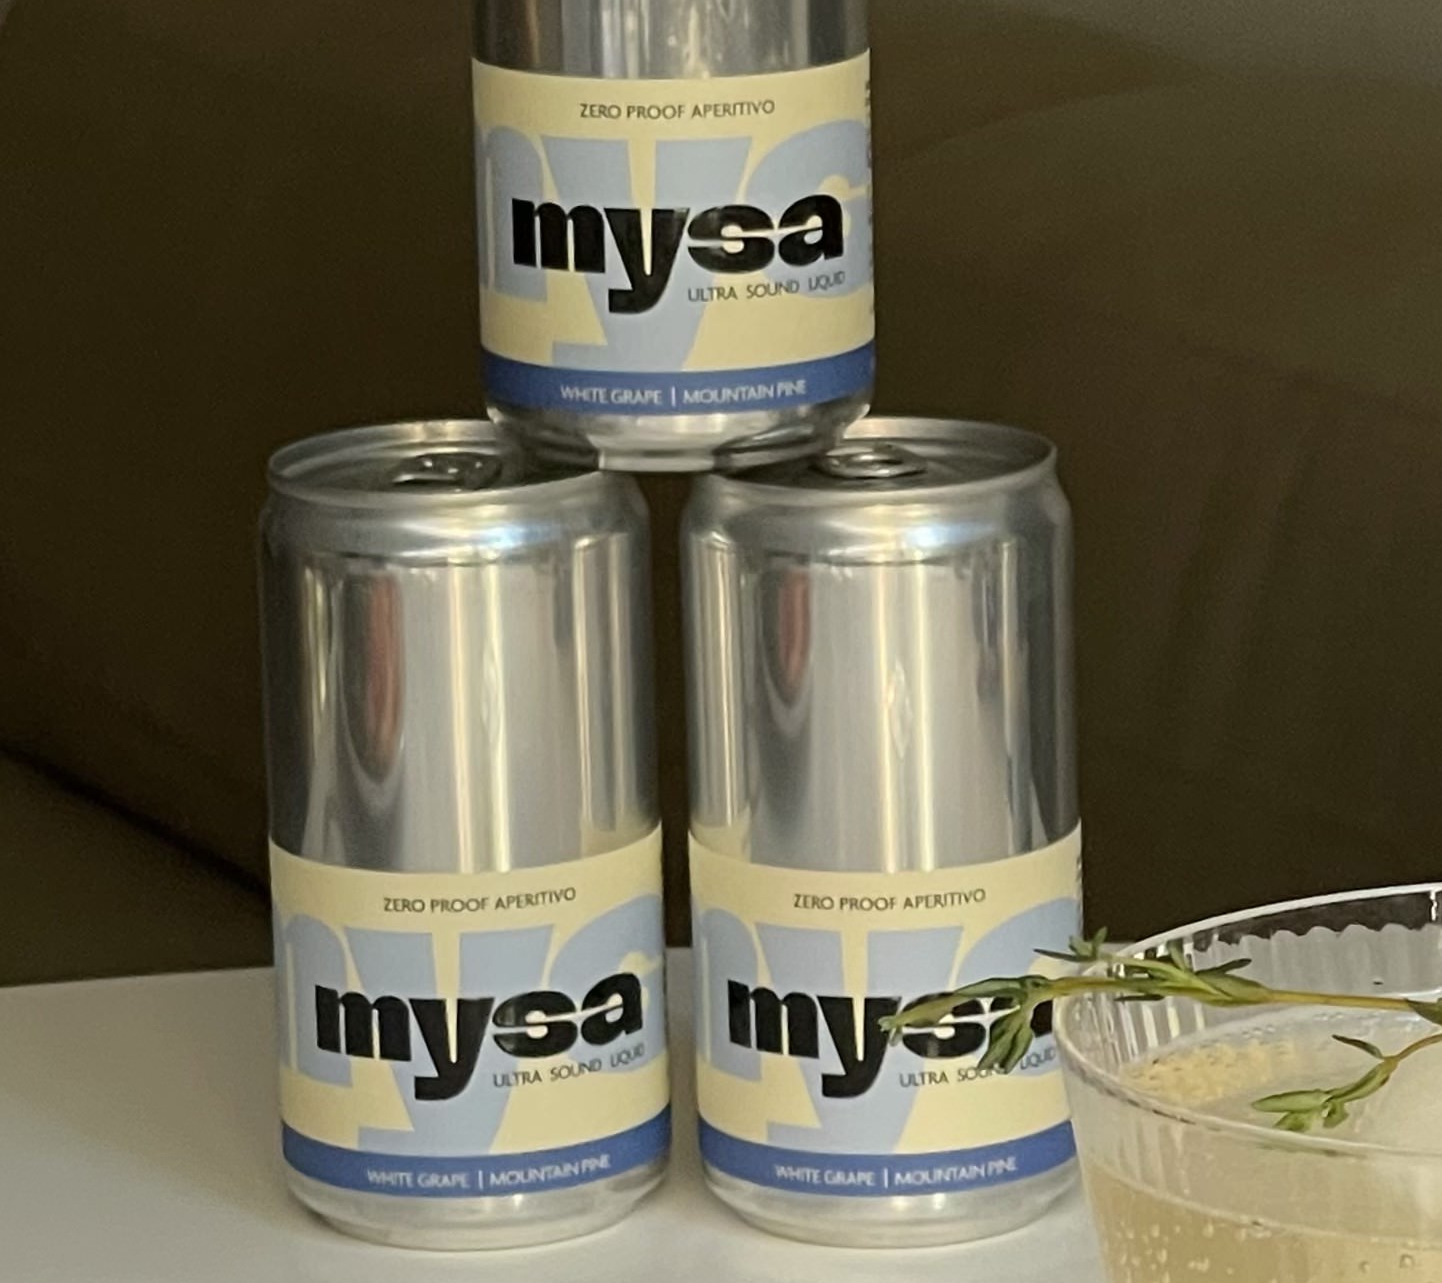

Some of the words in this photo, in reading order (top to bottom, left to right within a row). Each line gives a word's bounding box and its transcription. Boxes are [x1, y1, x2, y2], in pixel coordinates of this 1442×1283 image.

[579, 103, 622, 119] ZERO
[627, 104, 685, 119] PROOF
[691, 99, 776, 118] APERITIVO
[512, 194, 844, 314] mysa
[687, 286, 738, 302] ULTRA
[746, 280, 800, 299] SOUND
[808, 270, 845, 291] LIQUID
[560, 384, 608, 404] WHITE
[610, 388, 662, 405] GRAPE
[683, 384, 774, 404] MOUNTAIN
[777, 379, 807, 397] PINE
[383, 897, 425, 913] ZERO
[430, 897, 489, 913] PROOF
[494, 886, 576, 910] APERITIVO
[793, 894, 835, 910] ZERO
[839, 896, 897, 911] PROOF
[903, 888, 986, 910] APERITIVO
[315, 971, 643, 1101] mysa
[493, 1069, 542, 1087] ULTRA
[550, 1058, 602, 1082] SOUND
[610, 1042, 645, 1068] LIQUID
[899, 1070, 949, 1087] ULTRA
[367, 1169, 413, 1188] WHITE
[417, 1172, 470, 1188] GRAPE
[489, 1162, 580, 1187] MOUNTAIN
[581, 1154, 611, 1173] PINE
[776, 1165, 820, 1184] WHITE
[823, 1169, 875, 1186] GRAPE
[895, 1164, 985, 1186] MOUNTAIN
[987, 1156, 1017, 1172] PINE
